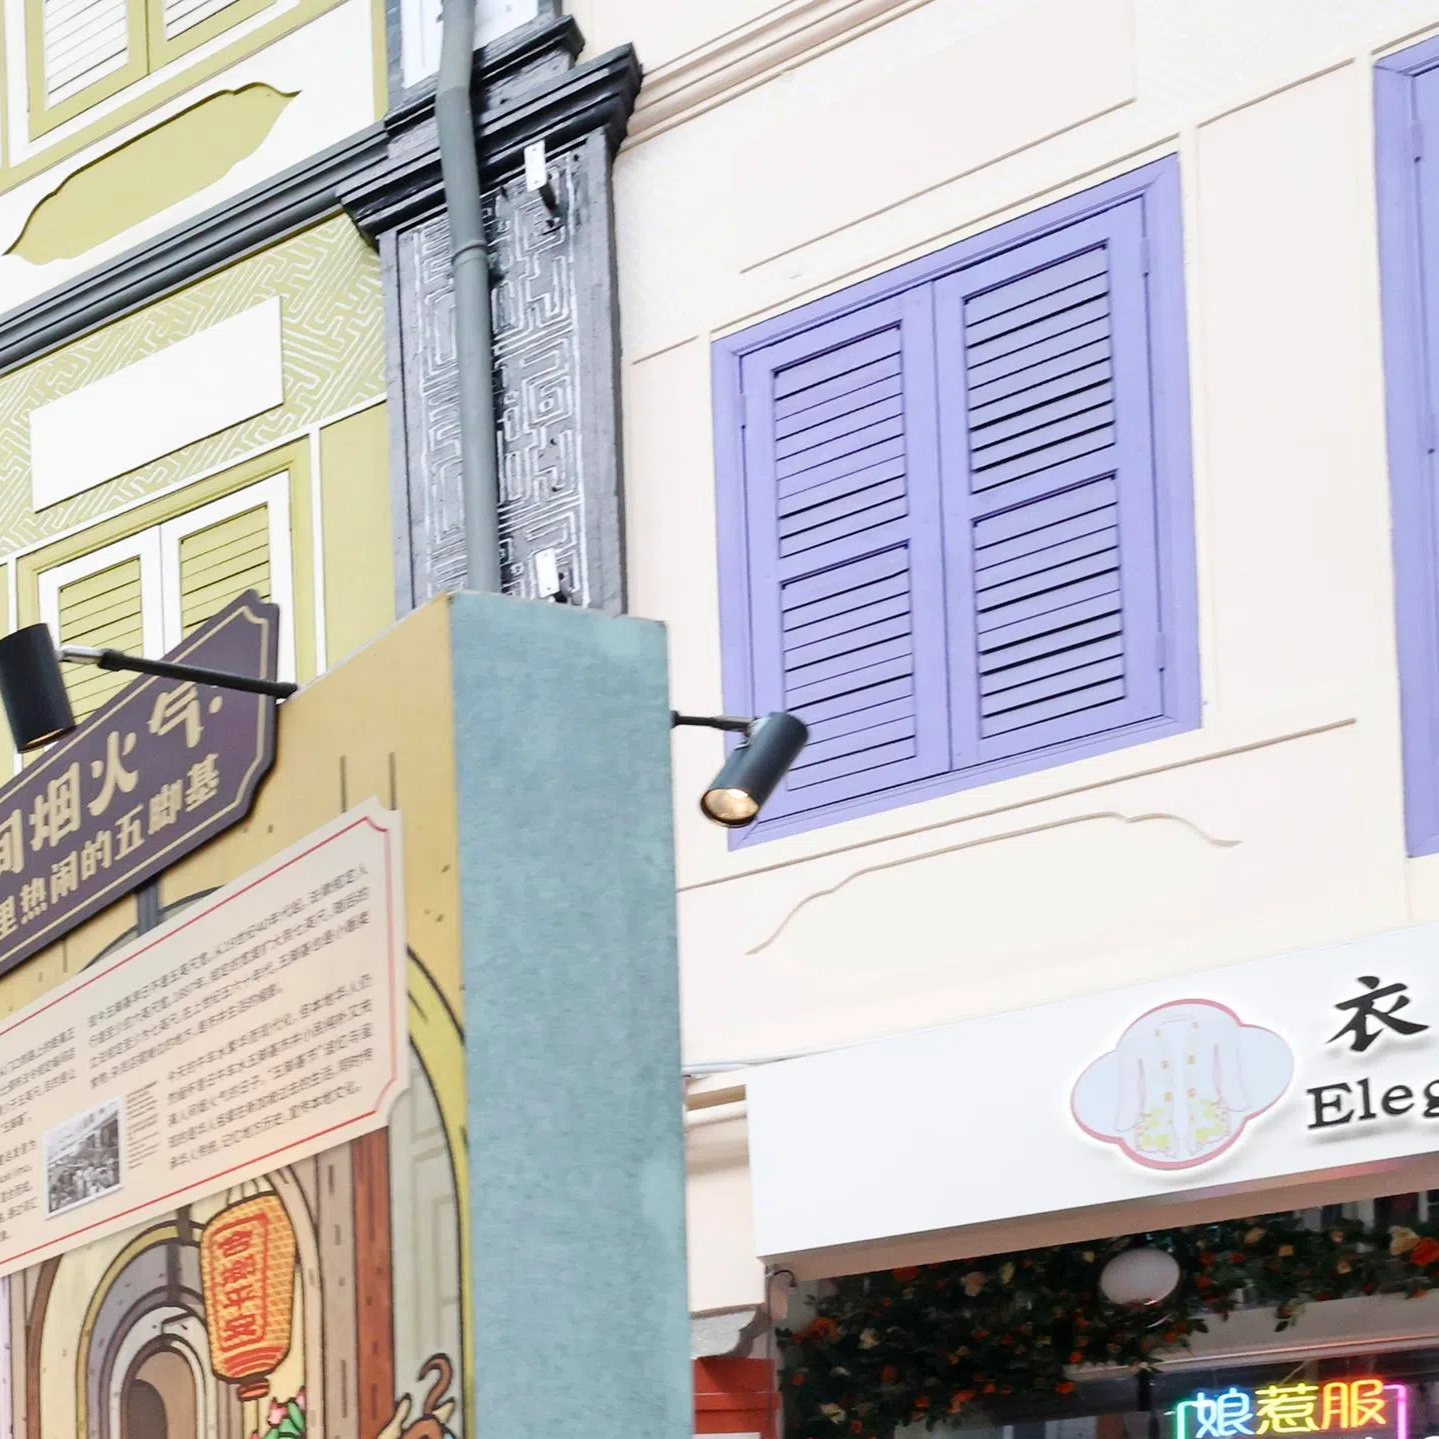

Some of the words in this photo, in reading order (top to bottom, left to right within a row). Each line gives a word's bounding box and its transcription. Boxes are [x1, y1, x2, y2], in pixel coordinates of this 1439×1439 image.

[1324, 975, 1430, 1051] 衣
[1195, 1378, 1388, 1439] 娘惹服
